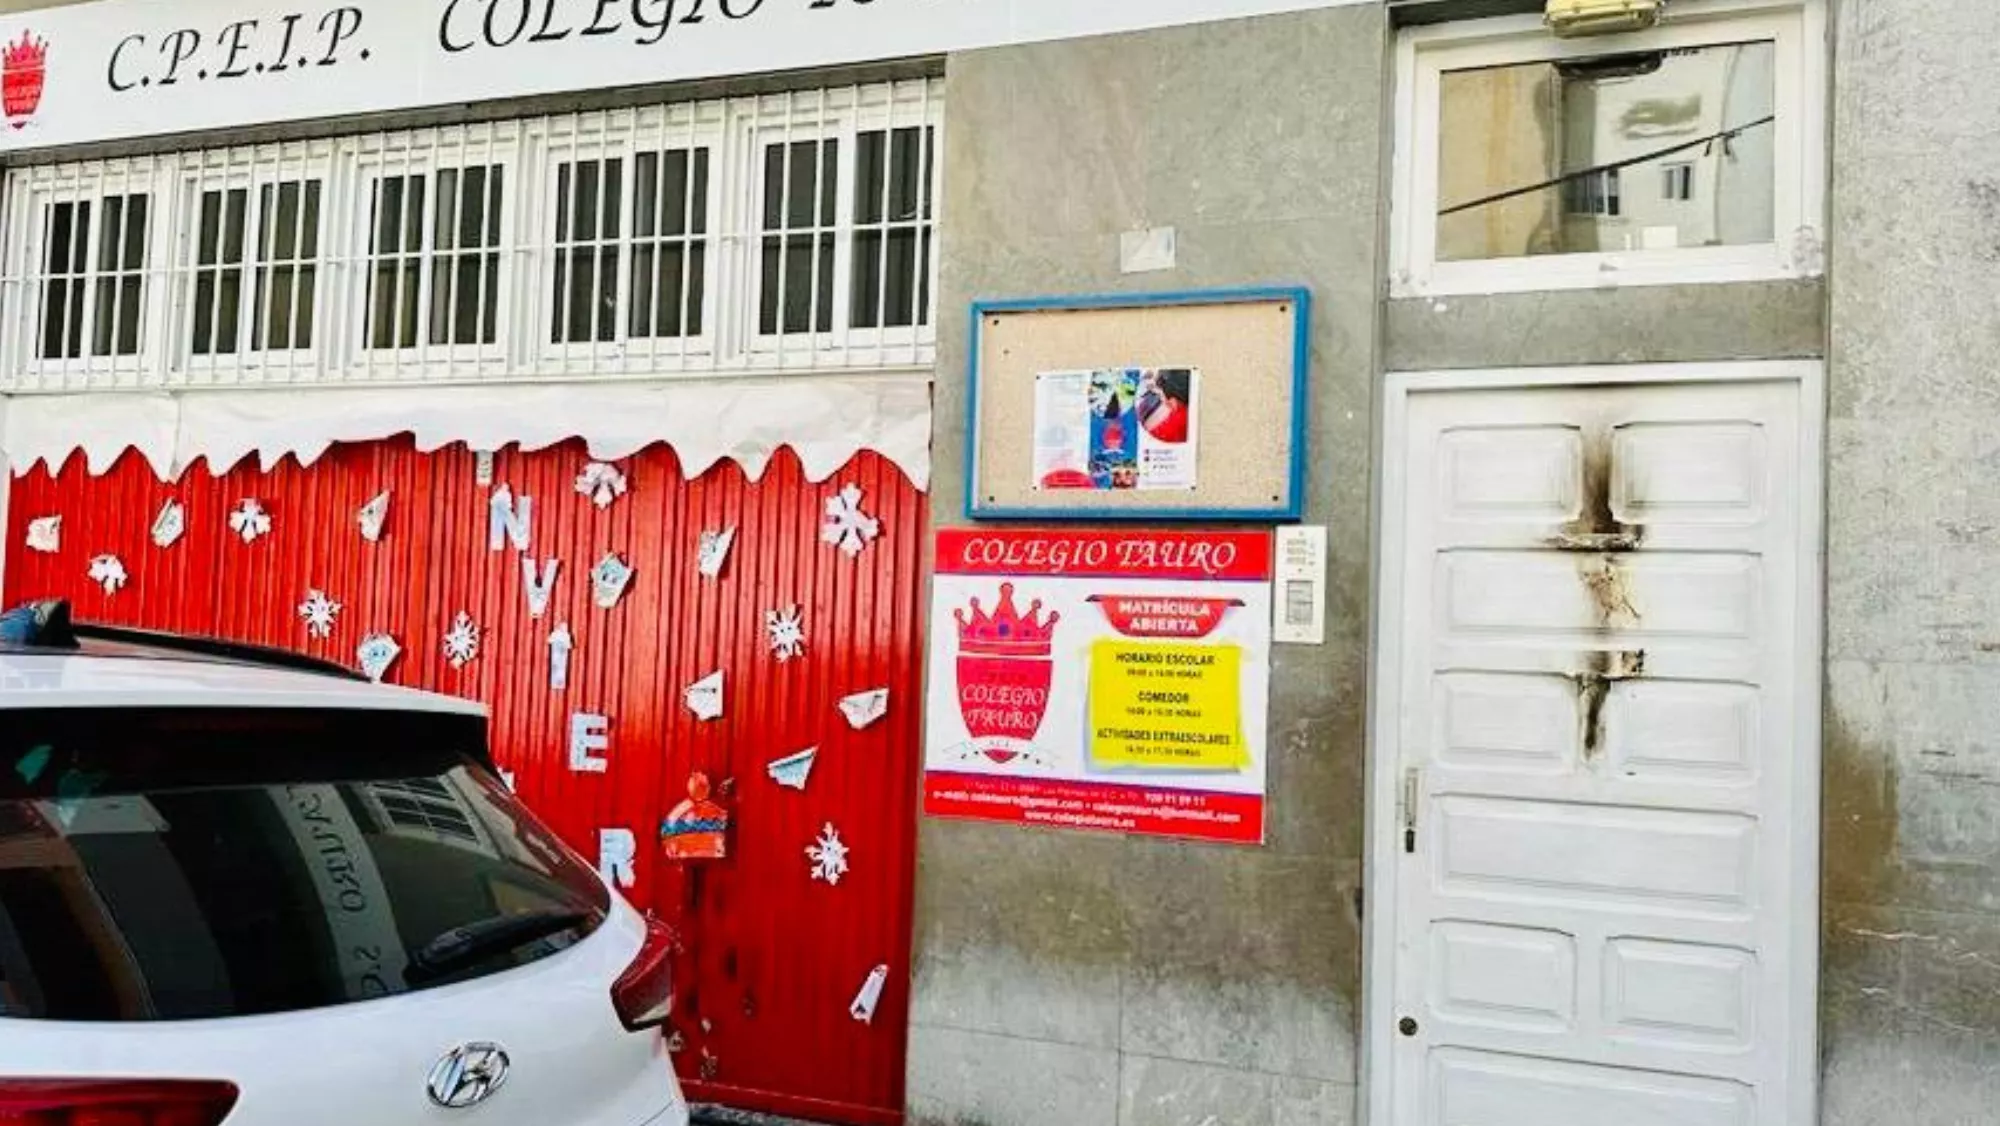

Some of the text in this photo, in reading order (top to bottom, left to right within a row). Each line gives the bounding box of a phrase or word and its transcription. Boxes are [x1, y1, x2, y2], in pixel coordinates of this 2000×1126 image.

[107, 11, 371, 91] C.P.E.I.P.
[963, 538, 1236, 573] COLEGIO TAURO
[1130, 617, 1198, 632] ABIERTA
[1116, 653, 1215, 666] HORARIO ESCOLAR
[1138, 690, 1189, 703] COMEDOR
